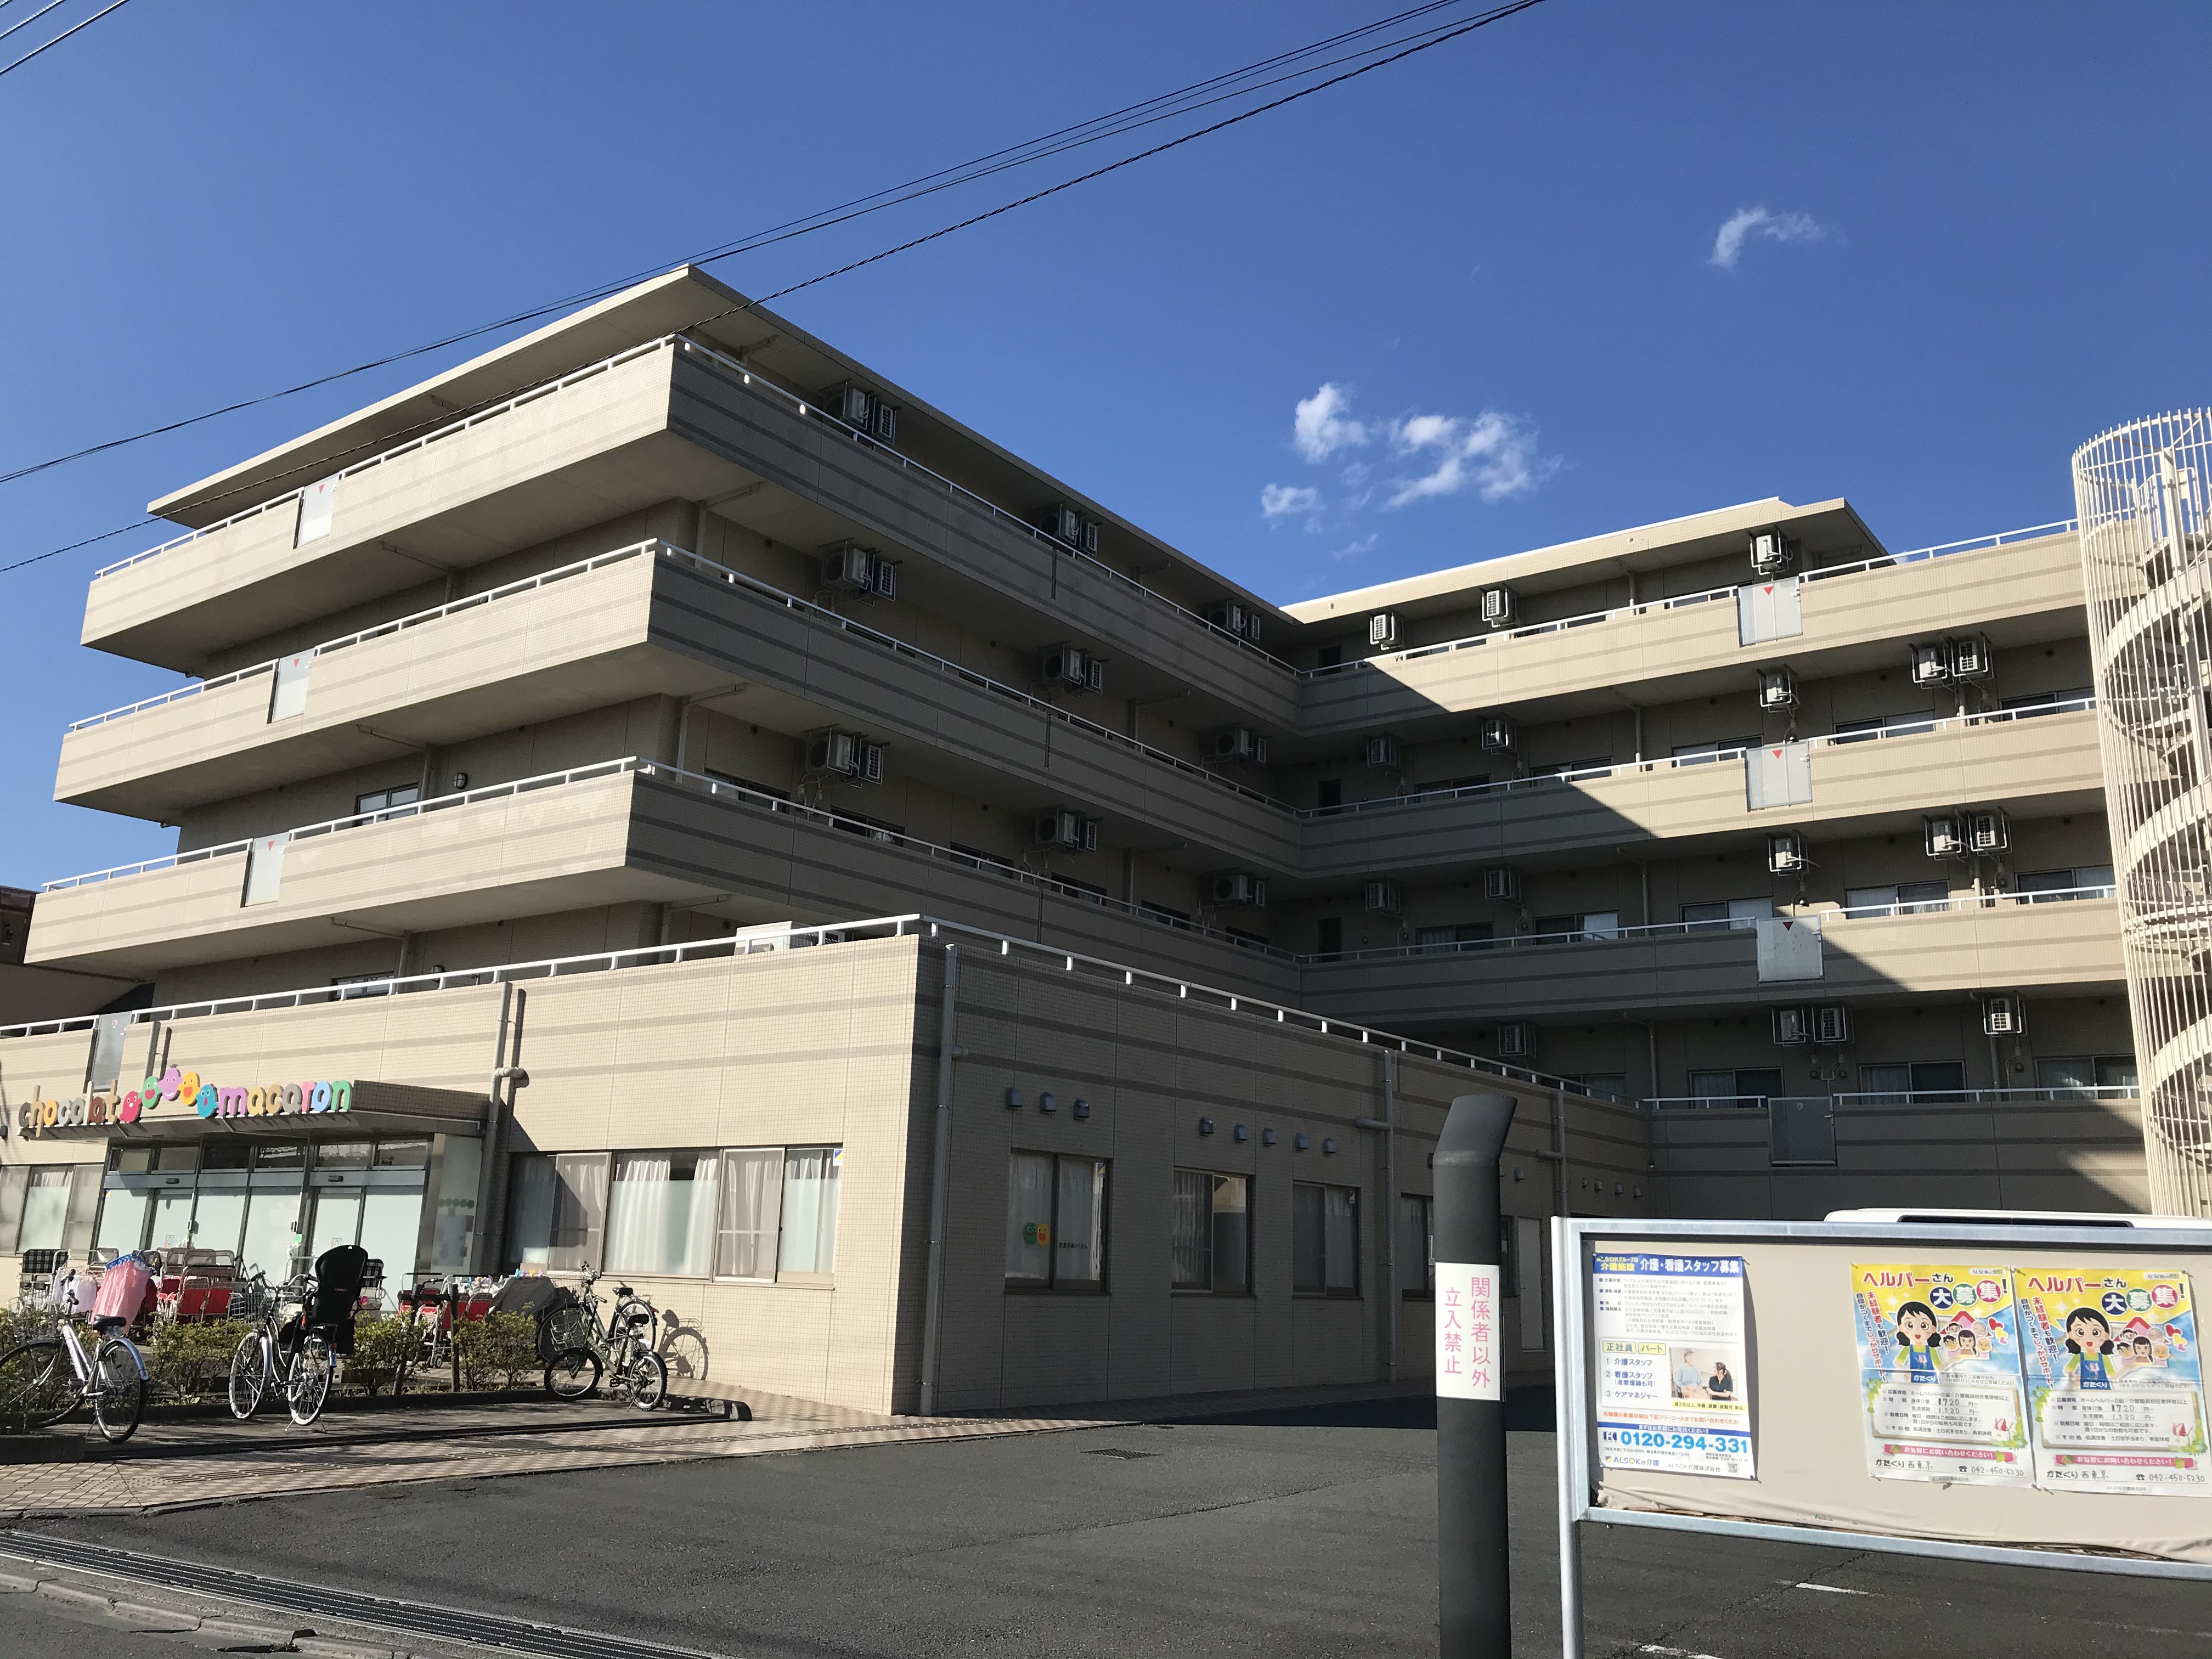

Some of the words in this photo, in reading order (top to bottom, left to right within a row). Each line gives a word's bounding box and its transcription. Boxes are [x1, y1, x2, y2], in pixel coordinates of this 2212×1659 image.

[18, 1079, 121, 1137] chocolat
[217, 1080, 352, 1116] macaron
[1640, 1257, 1739, 1273] 介護・看護スタッフ募集
[1863, 1272, 1954, 1288] ヘルパーさん
[2028, 1277, 2127, 1293] ヘルパーさん
[1444, 1287, 1462, 1374] 立入禁止
[1471, 1277, 1491, 1389] 関係者以外
[1606, 1342, 1633, 1352] 正社員
[1641, 1344, 1663, 1353] パート
[1614, 1358, 1652, 1366] 介護スタッフ
[1615, 1371, 1652, 1379] 看護スタッフ
[1615, 1391, 1658, 1399] ケアマネジャー
[1621, 1431, 1747, 1453] 0120-294-331
[1613, 1456, 1660, 1466] ALSOKの介護
[1875, 1459, 1905, 1468] かたくり
[1667, 1463, 1721, 1472] ALSOK介護株式会社
[1971, 1466, 2024, 1476] 042-450-5230
[2149, 1474, 2205, 1482] 042-450-5230
